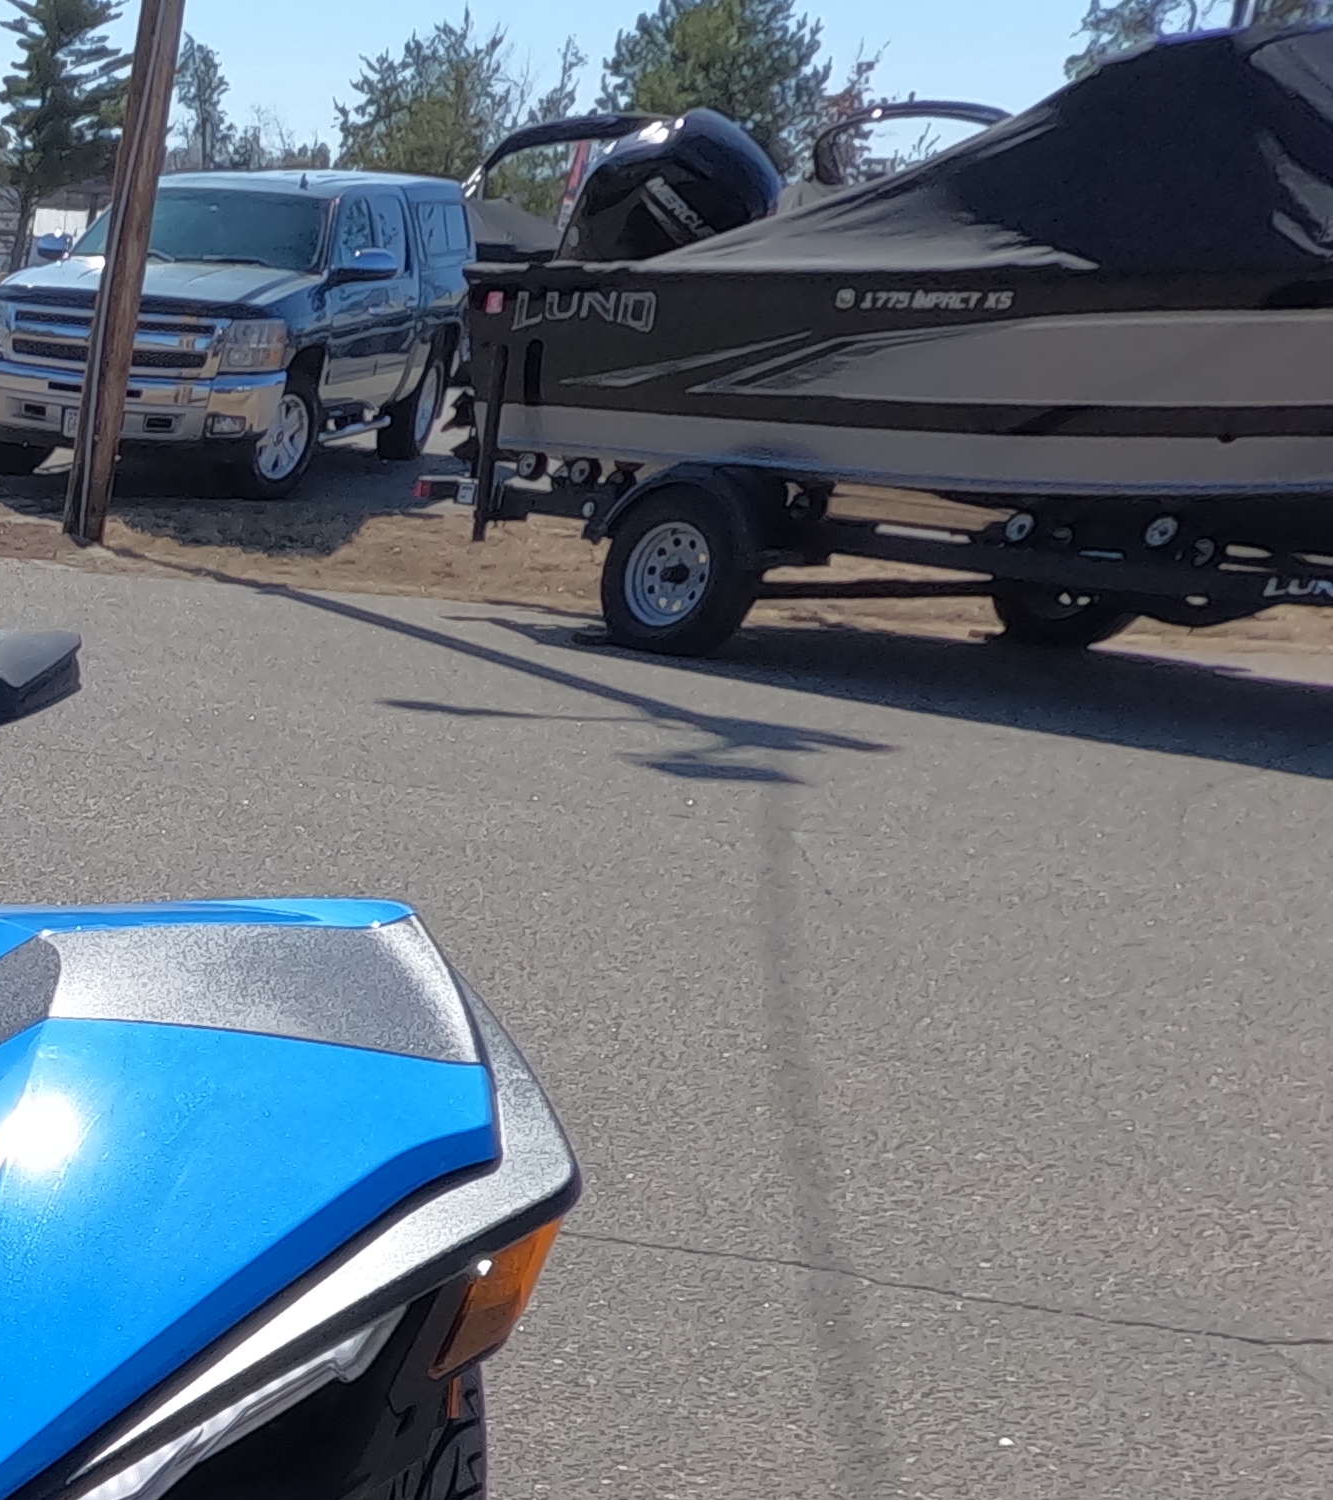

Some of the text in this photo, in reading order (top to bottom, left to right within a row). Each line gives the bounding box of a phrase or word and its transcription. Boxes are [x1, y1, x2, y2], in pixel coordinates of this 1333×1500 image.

[511, 290, 657, 333] LUND
[859, 289, 1015, 311] 1775 IMPACT XS
